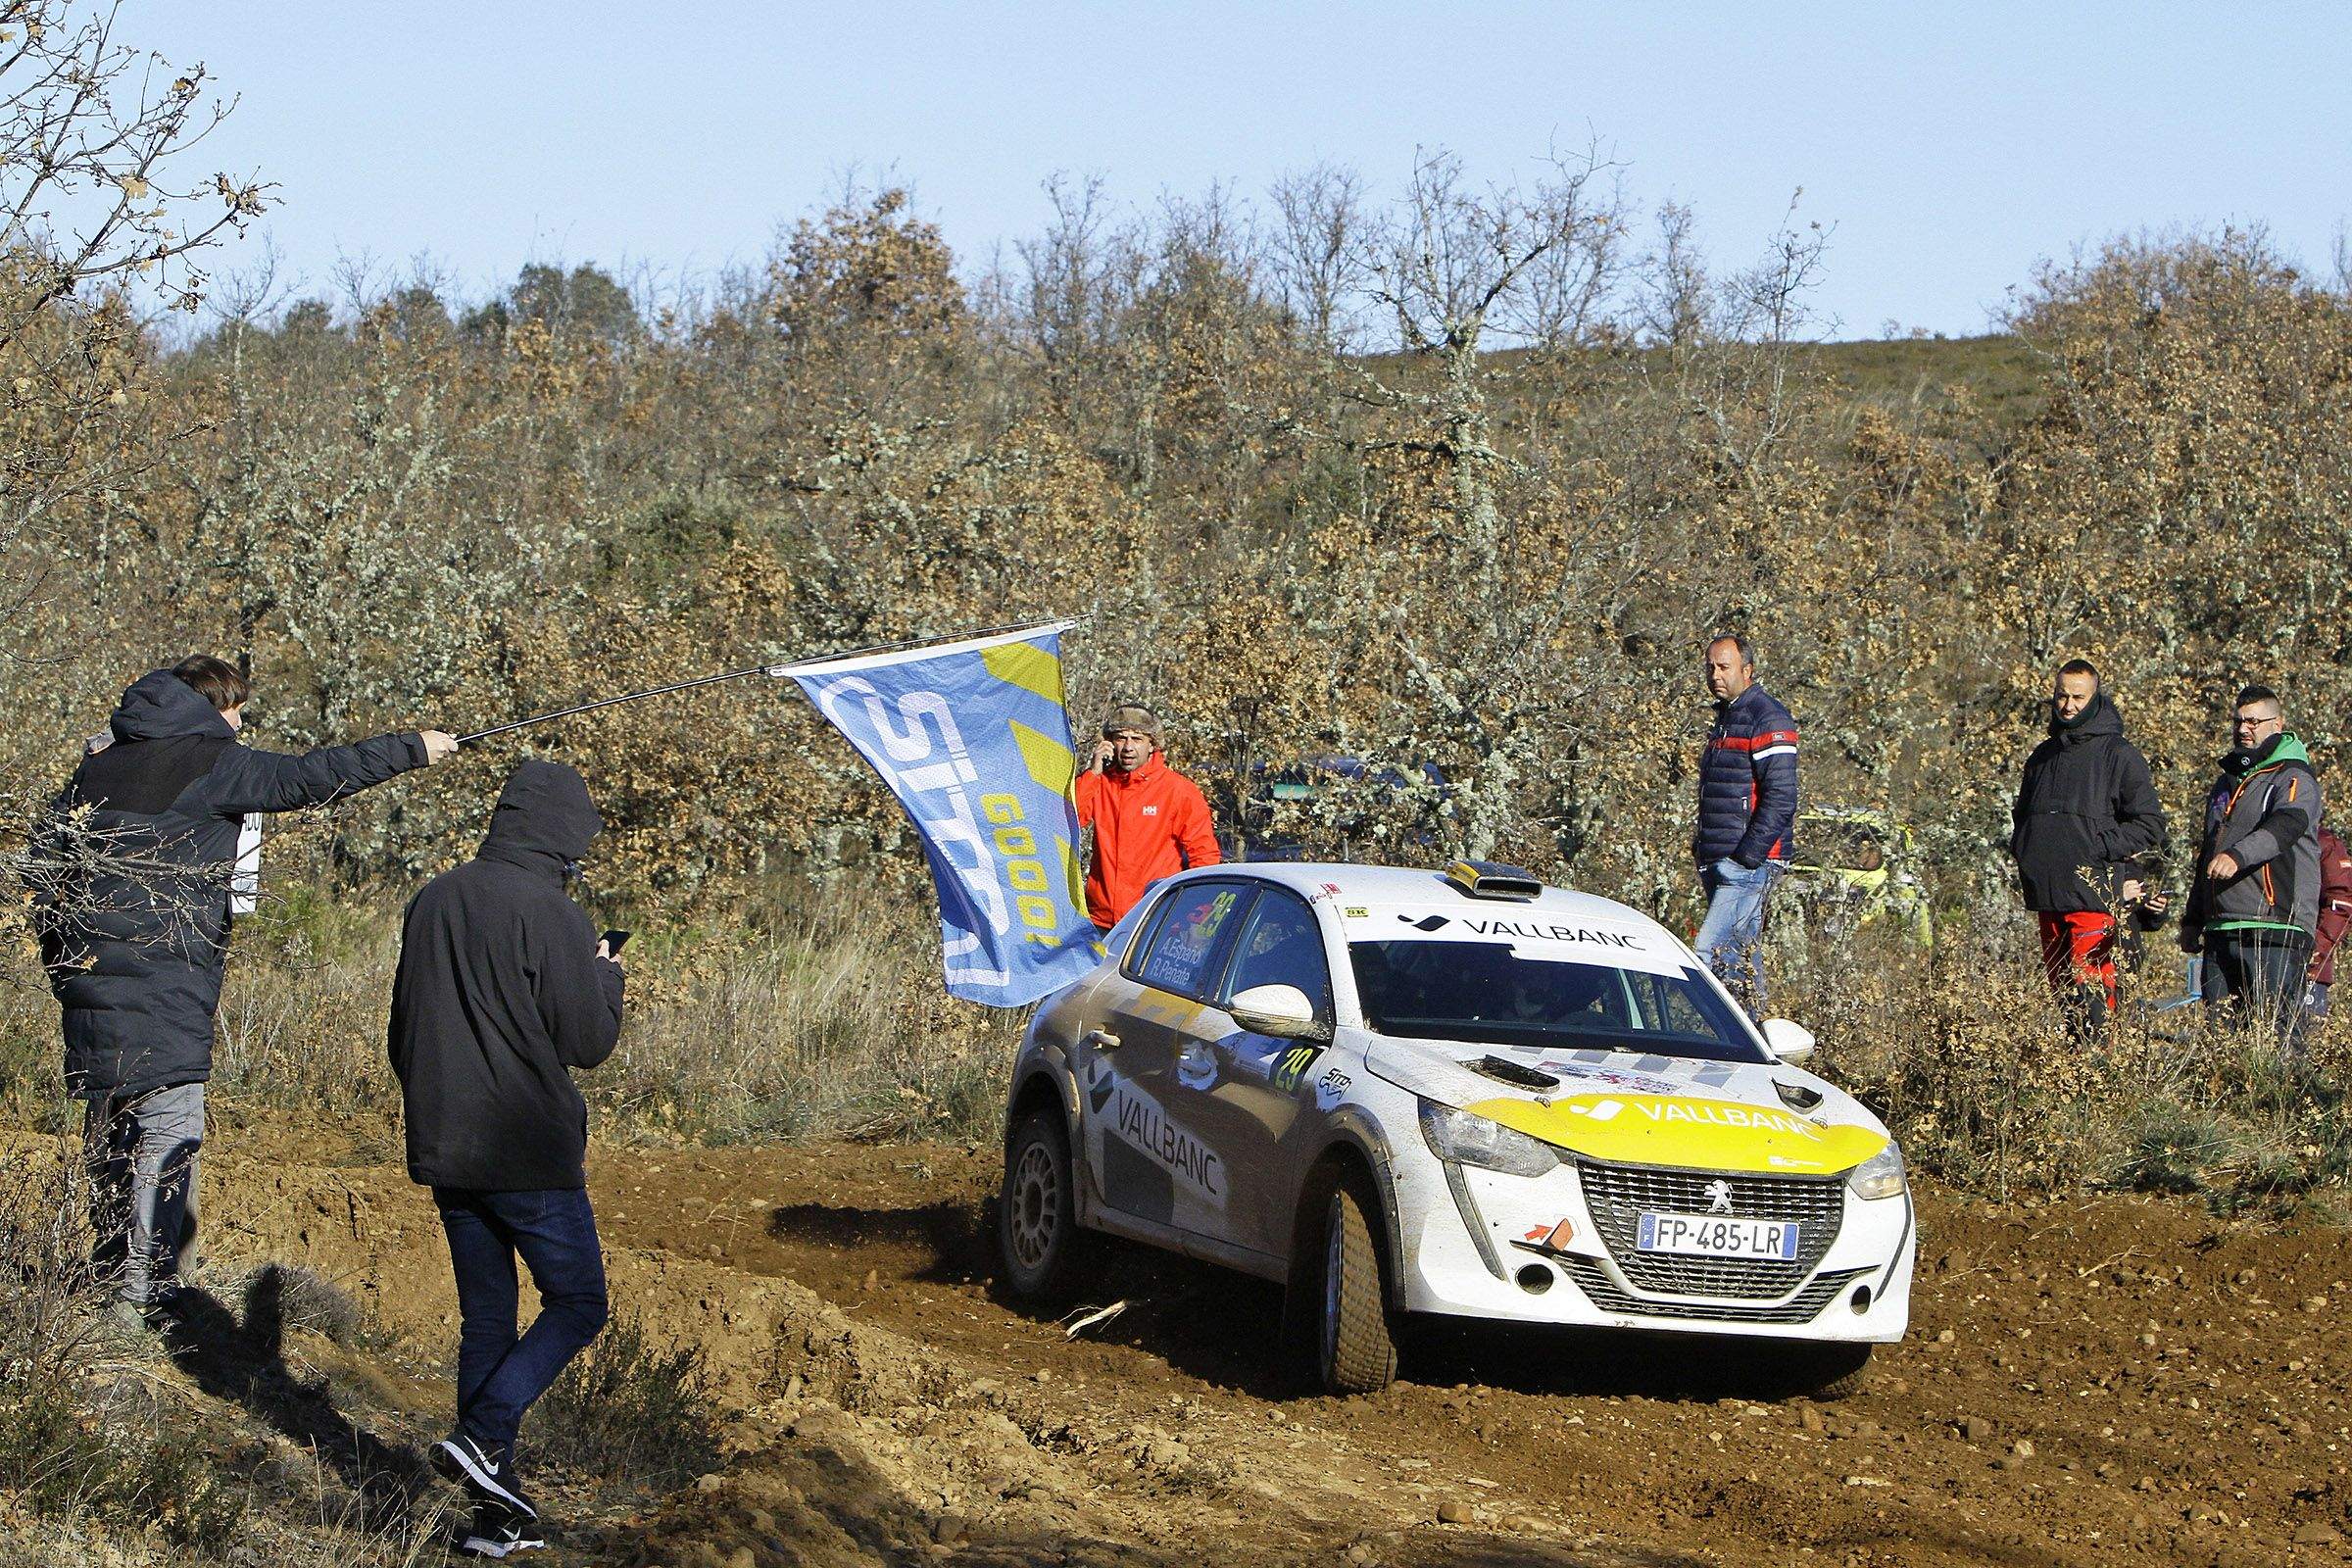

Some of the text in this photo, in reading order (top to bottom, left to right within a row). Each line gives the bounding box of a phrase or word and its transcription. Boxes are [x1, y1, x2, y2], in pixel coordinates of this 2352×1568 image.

[980, 793, 1062, 947] GOOO!
[1462, 919, 1646, 951] VALLBANC
[1275, 1047, 1314, 1092] 29
[1119, 1089, 1216, 1196] VALLBANC
[1635, 1102, 1822, 1142] VALLBANC
[1656, 1219, 1782, 1254] FP-485-LR
